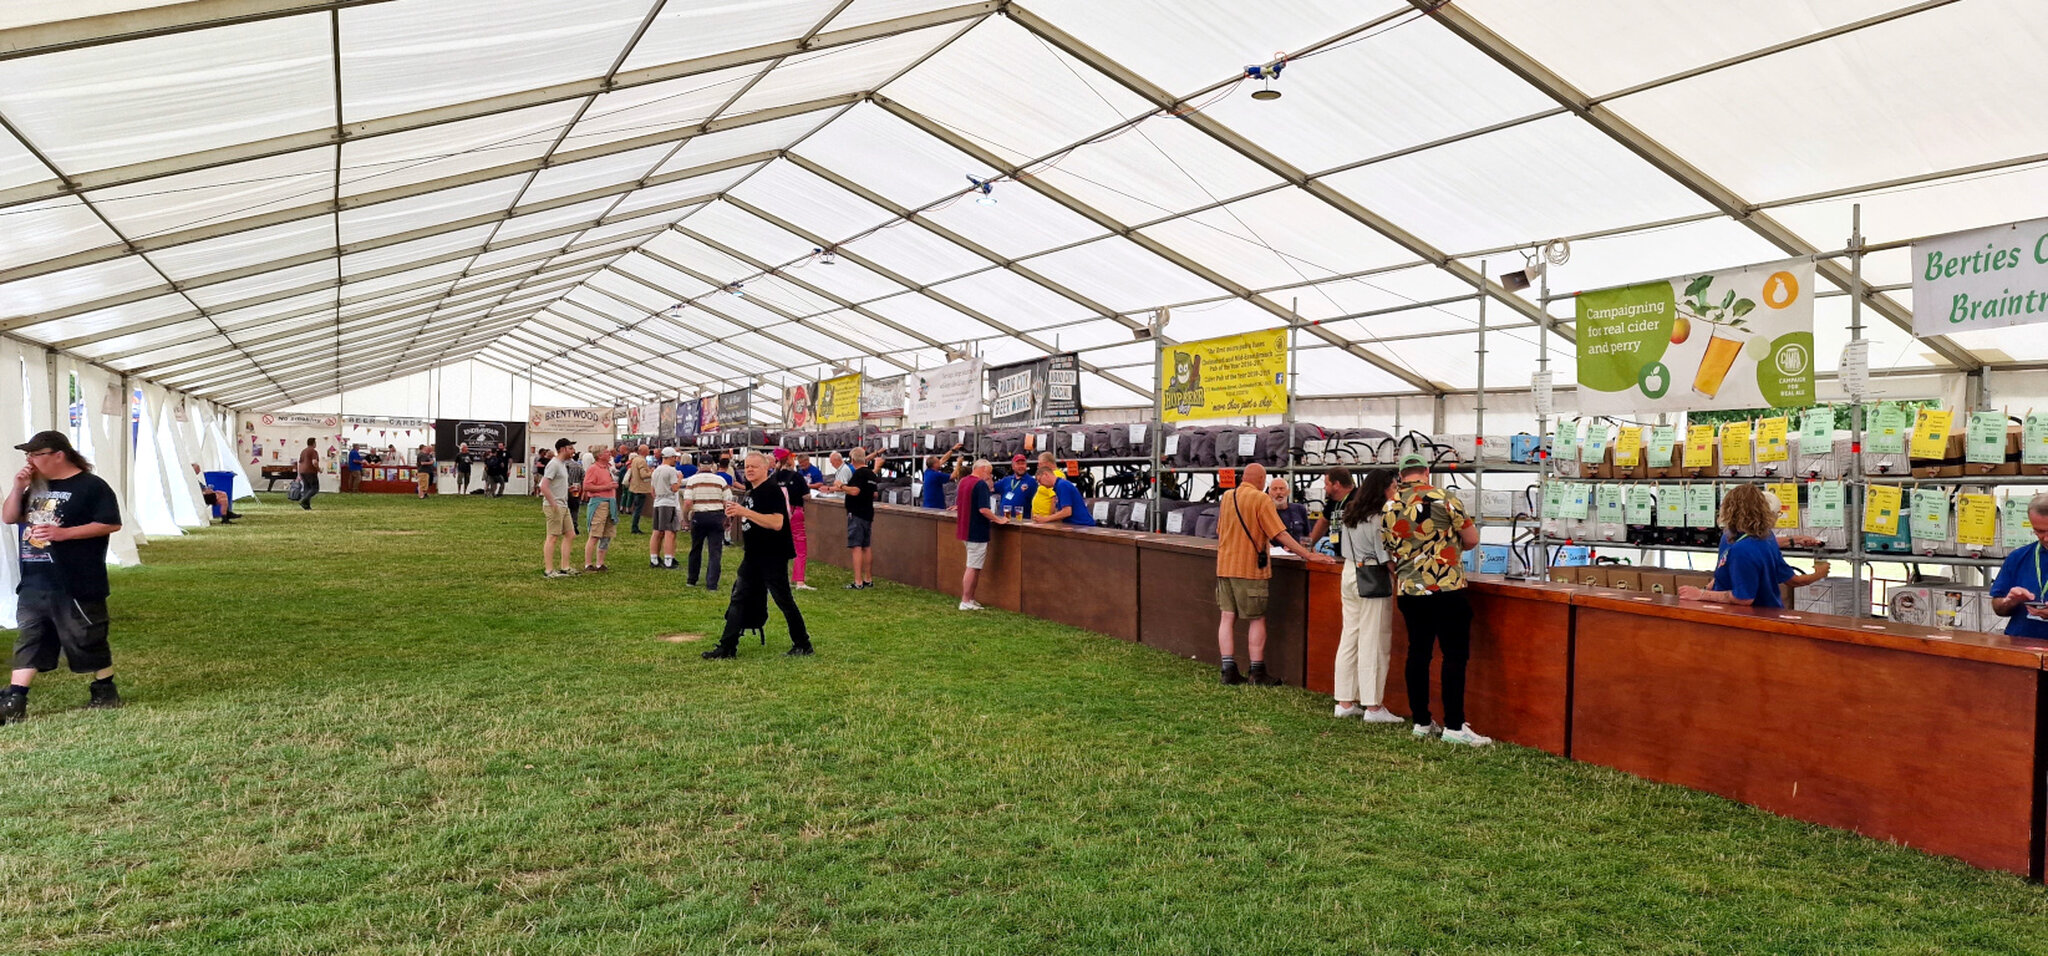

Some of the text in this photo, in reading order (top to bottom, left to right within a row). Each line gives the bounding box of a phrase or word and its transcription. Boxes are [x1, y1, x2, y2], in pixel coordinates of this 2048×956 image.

[1924, 243, 2022, 281] Berties
[1586, 300, 1665, 320] Campaigning
[1949, 287, 2048, 324] Braintr
[1603, 321, 1625, 336] real
[1627, 319, 1660, 333] cider
[1588, 340, 1642, 356] and perry
[348, 416, 422, 427] BEER CARDS
[544, 409, 599, 422] BRENTWOOD
